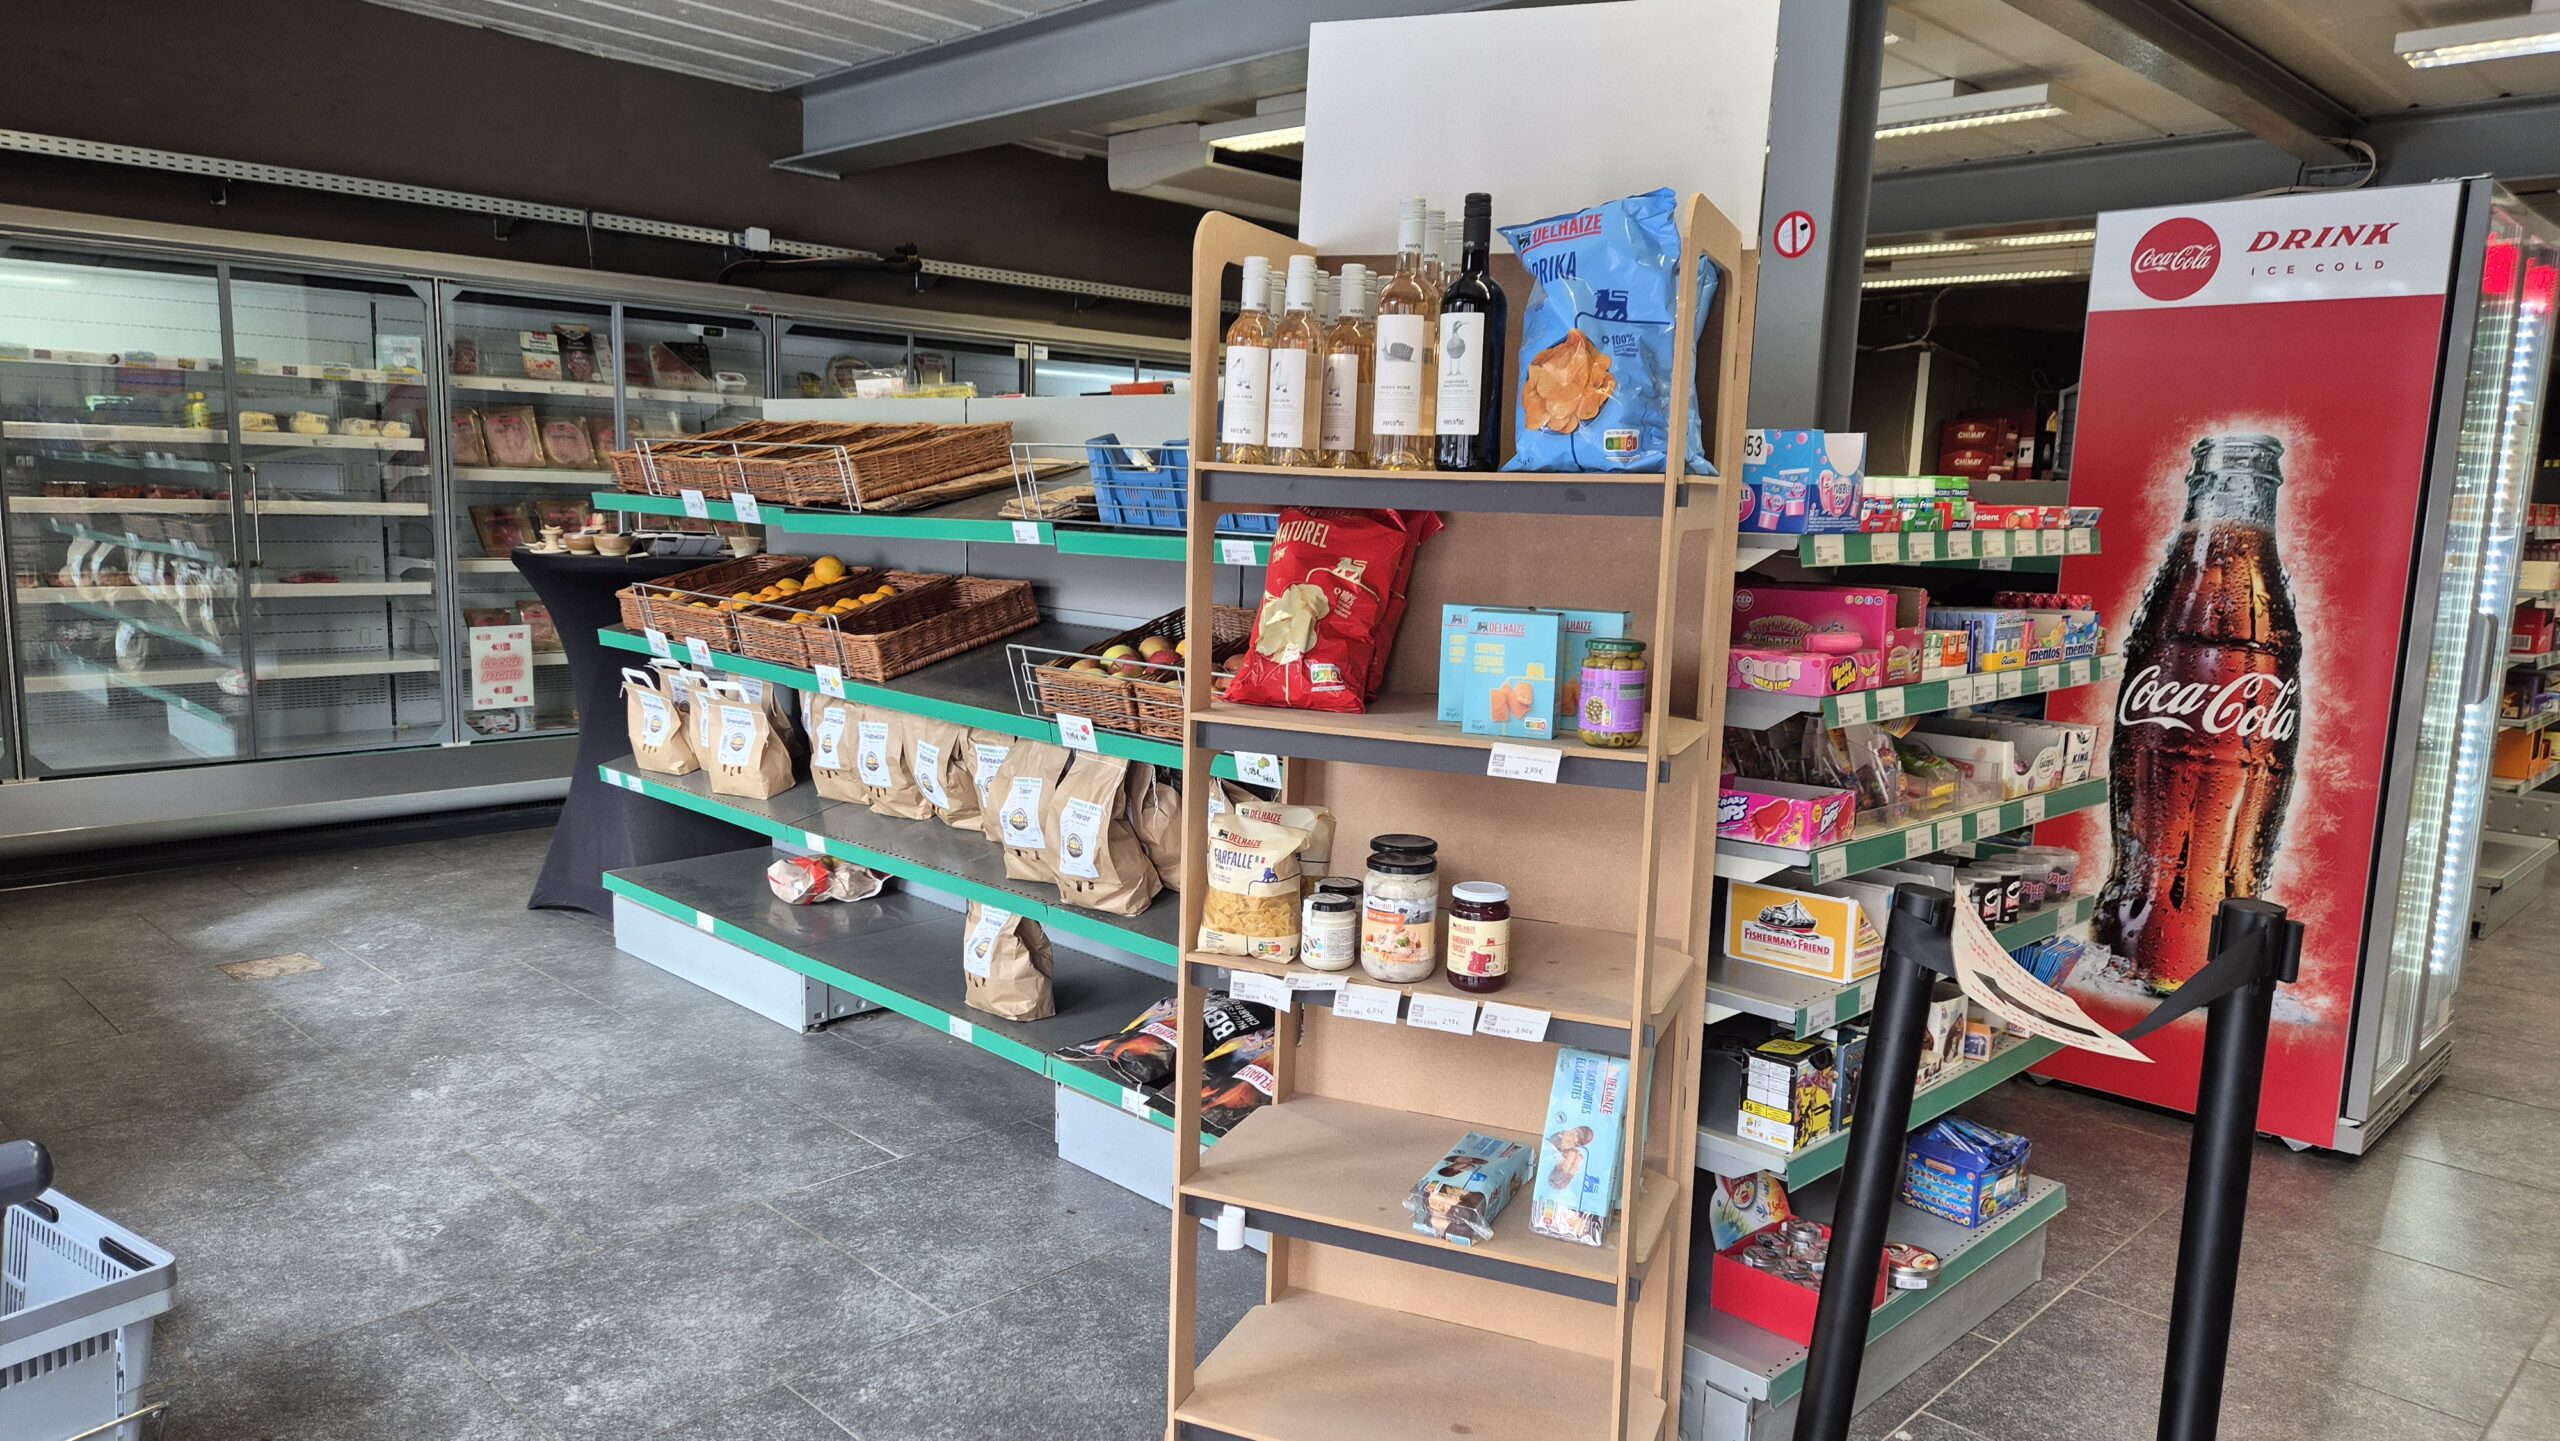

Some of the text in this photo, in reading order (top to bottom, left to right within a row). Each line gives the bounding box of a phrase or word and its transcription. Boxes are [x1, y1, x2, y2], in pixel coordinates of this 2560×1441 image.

[1532, 213, 1603, 244] DELHAIZE
[2247, 222, 2400, 253] DRINK
[2134, 242, 2217, 274] Coca-Cola
[1531, 251, 1577, 285] PRIKA
[2251, 260, 2386, 277] ICE COLD
[1612, 333, 1636, 346] 100%
[1957, 431, 1986, 439] CHIMAY
[1954, 458, 1983, 466] CHIMAY
[1976, 513, 2000, 522] edent
[1274, 520, 1330, 549] NATUREL
[1735, 596, 1752, 604] ZED
[1489, 624, 1527, 635] DELHAIZE
[1564, 621, 1593, 632] LHAIZE
[2030, 647, 2061, 661] mentos
[2065, 642, 2095, 657] mentos
[2119, 665, 2298, 741] Coca-Cola
[2072, 752, 2089, 763] KING
[1249, 810, 1282, 824] DELHAIZE
[1228, 833, 1263, 848] DELHAIZE
[1214, 848, 1254, 870] FARFALLE
[1744, 928, 1798, 949] FISHERMAN'S
[1798, 939, 1830, 955] FRIEND
[1571, 1057, 1587, 1101] ECLAIRETTES
[1602, 1077, 1618, 1115] DELHAIZE
[1745, 1102, 1753, 1112] 36
